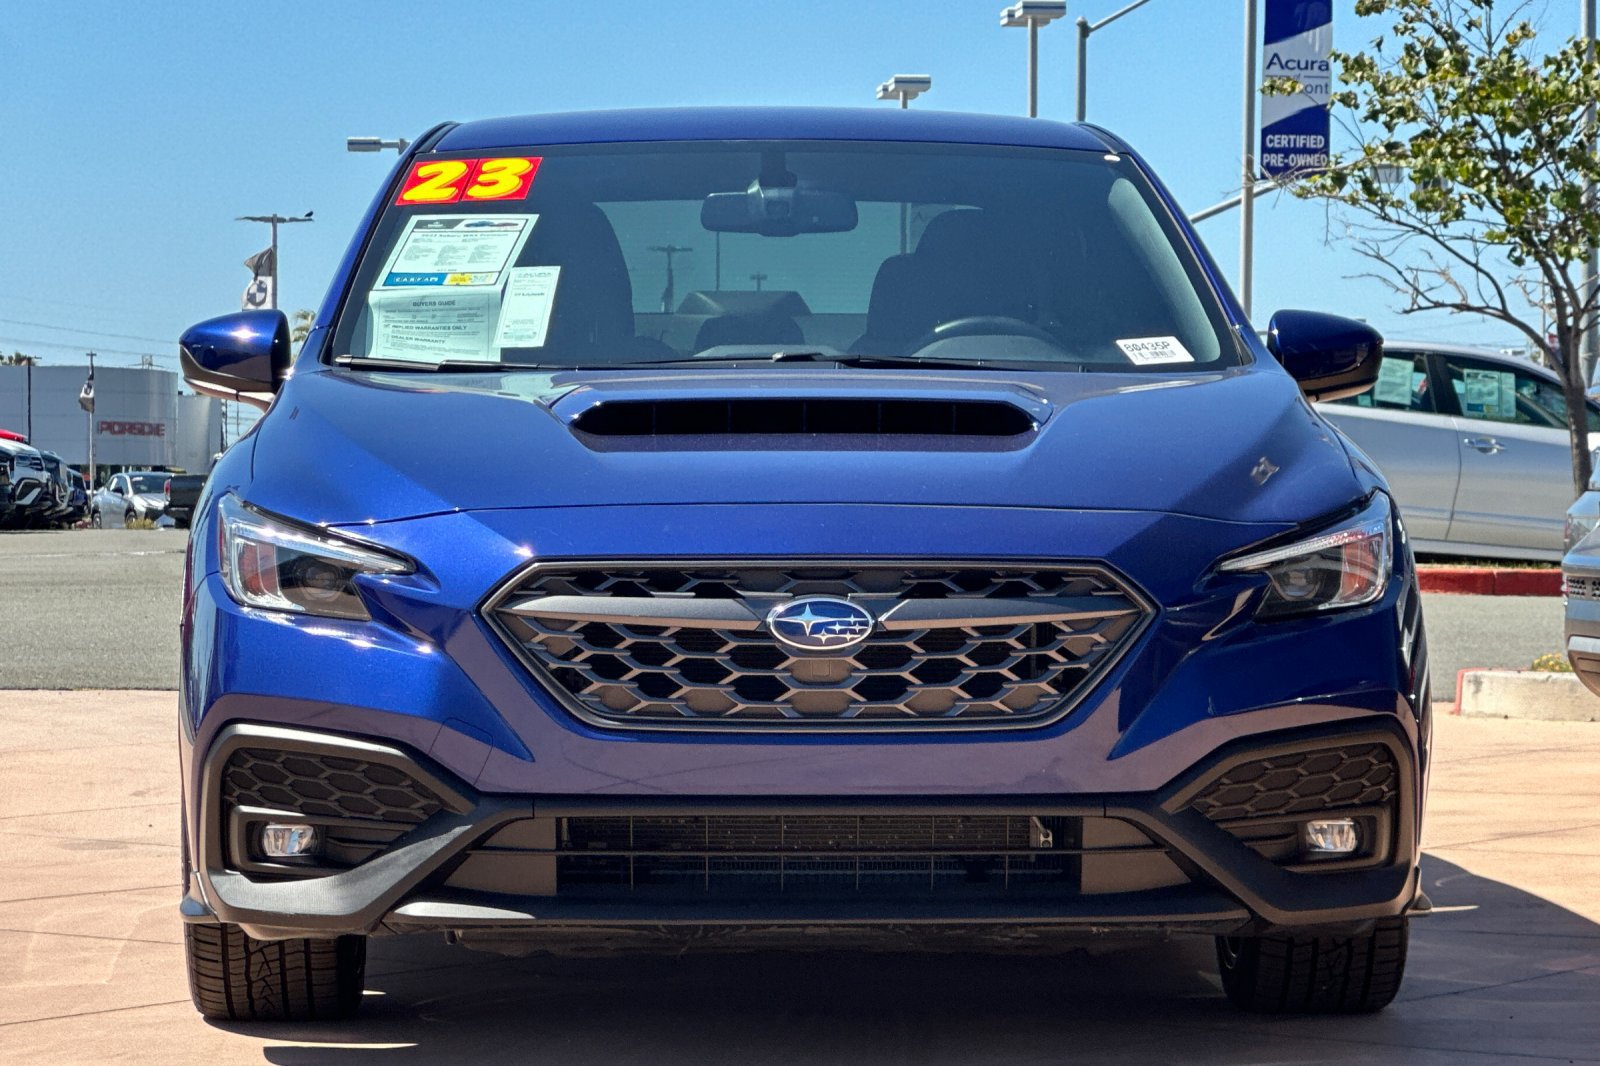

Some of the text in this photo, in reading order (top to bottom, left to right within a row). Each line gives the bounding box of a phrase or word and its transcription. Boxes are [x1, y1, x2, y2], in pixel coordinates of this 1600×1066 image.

[1265, 53, 1330, 71] Acura
[1265, 134, 1325, 148] CERTIFIED
[1262, 153, 1328, 167] PRE-OWNED
[403, 157, 533, 202] 23
